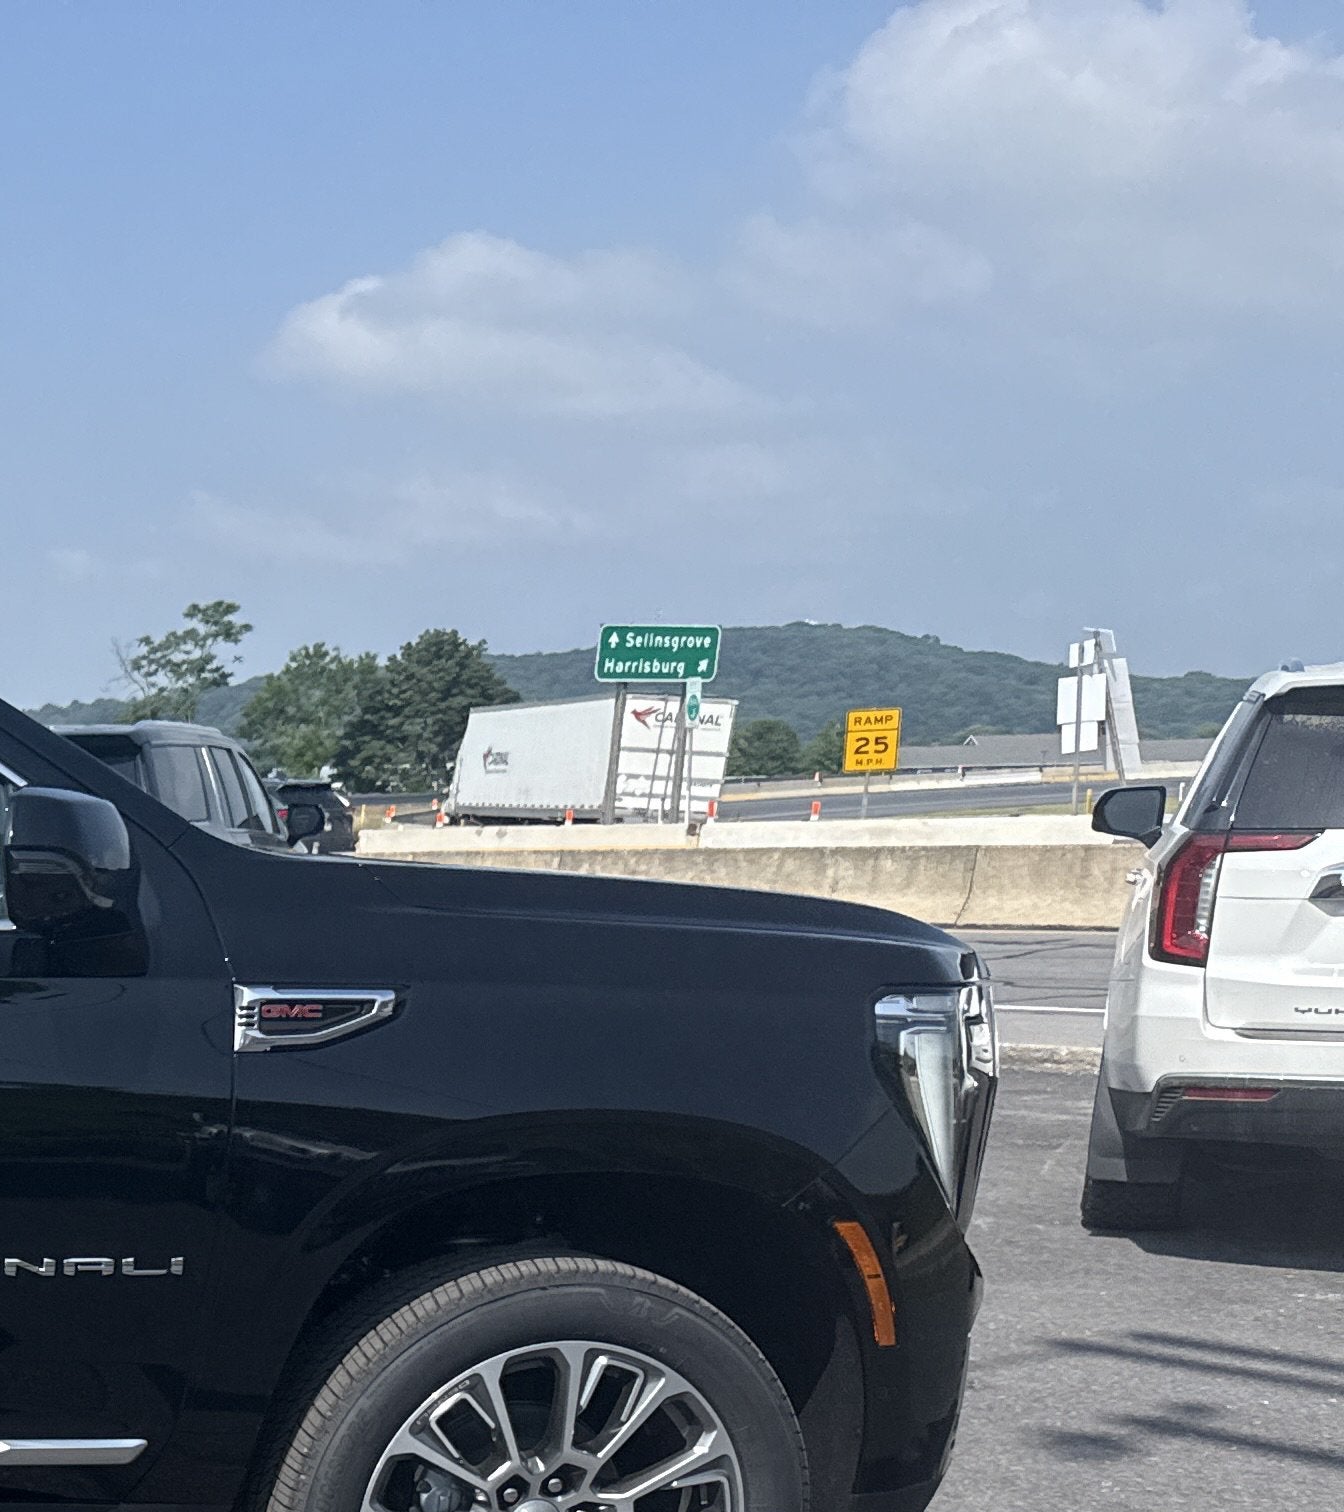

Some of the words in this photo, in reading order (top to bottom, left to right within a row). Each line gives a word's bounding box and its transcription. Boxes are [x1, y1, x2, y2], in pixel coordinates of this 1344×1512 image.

[625, 631, 712, 652] Selinsgrove
[603, 658, 685, 677] Harrisburg
[655, 711, 721, 727] CANAL
[853, 715, 894, 726] RAMP
[853, 736, 889, 755] 25
[261, 1004, 323, 1018] GMC
